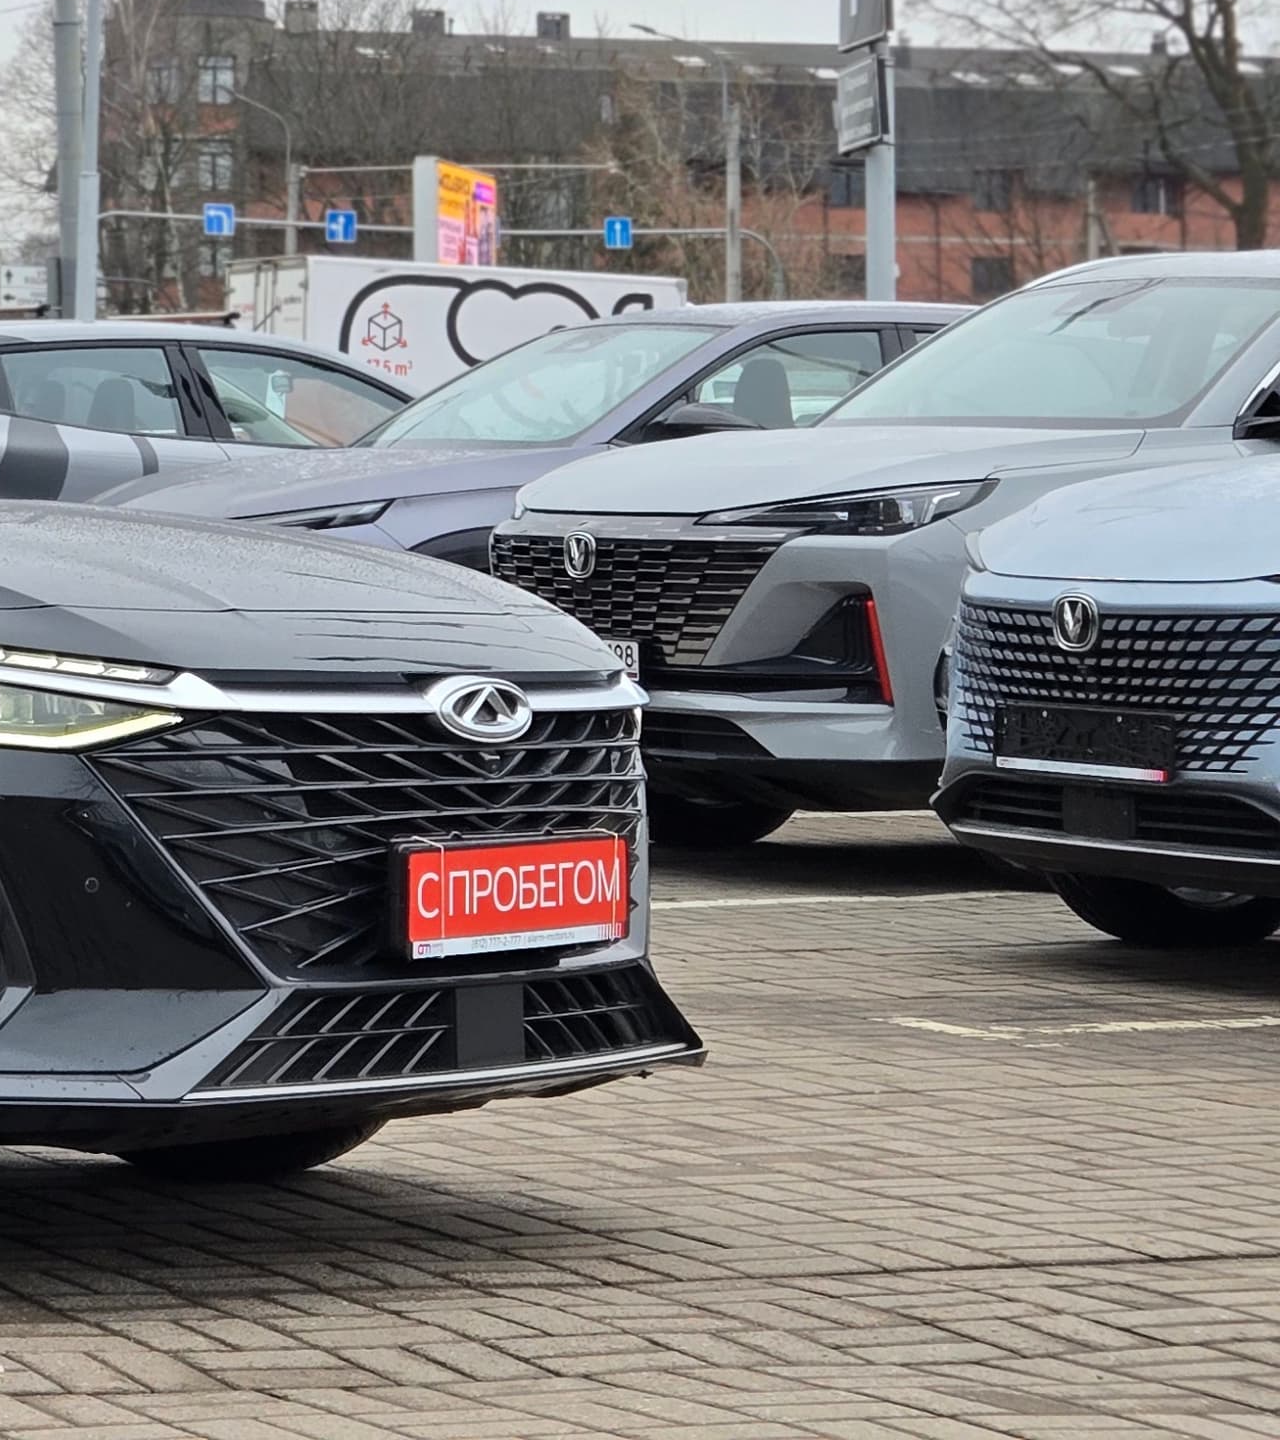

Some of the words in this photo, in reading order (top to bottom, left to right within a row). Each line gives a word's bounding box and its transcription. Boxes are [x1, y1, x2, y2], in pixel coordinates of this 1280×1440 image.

[608, 644, 633, 667] 98
[417, 872, 439, 918] С
[448, 857, 620, 916] ПРОБЕГОМ
